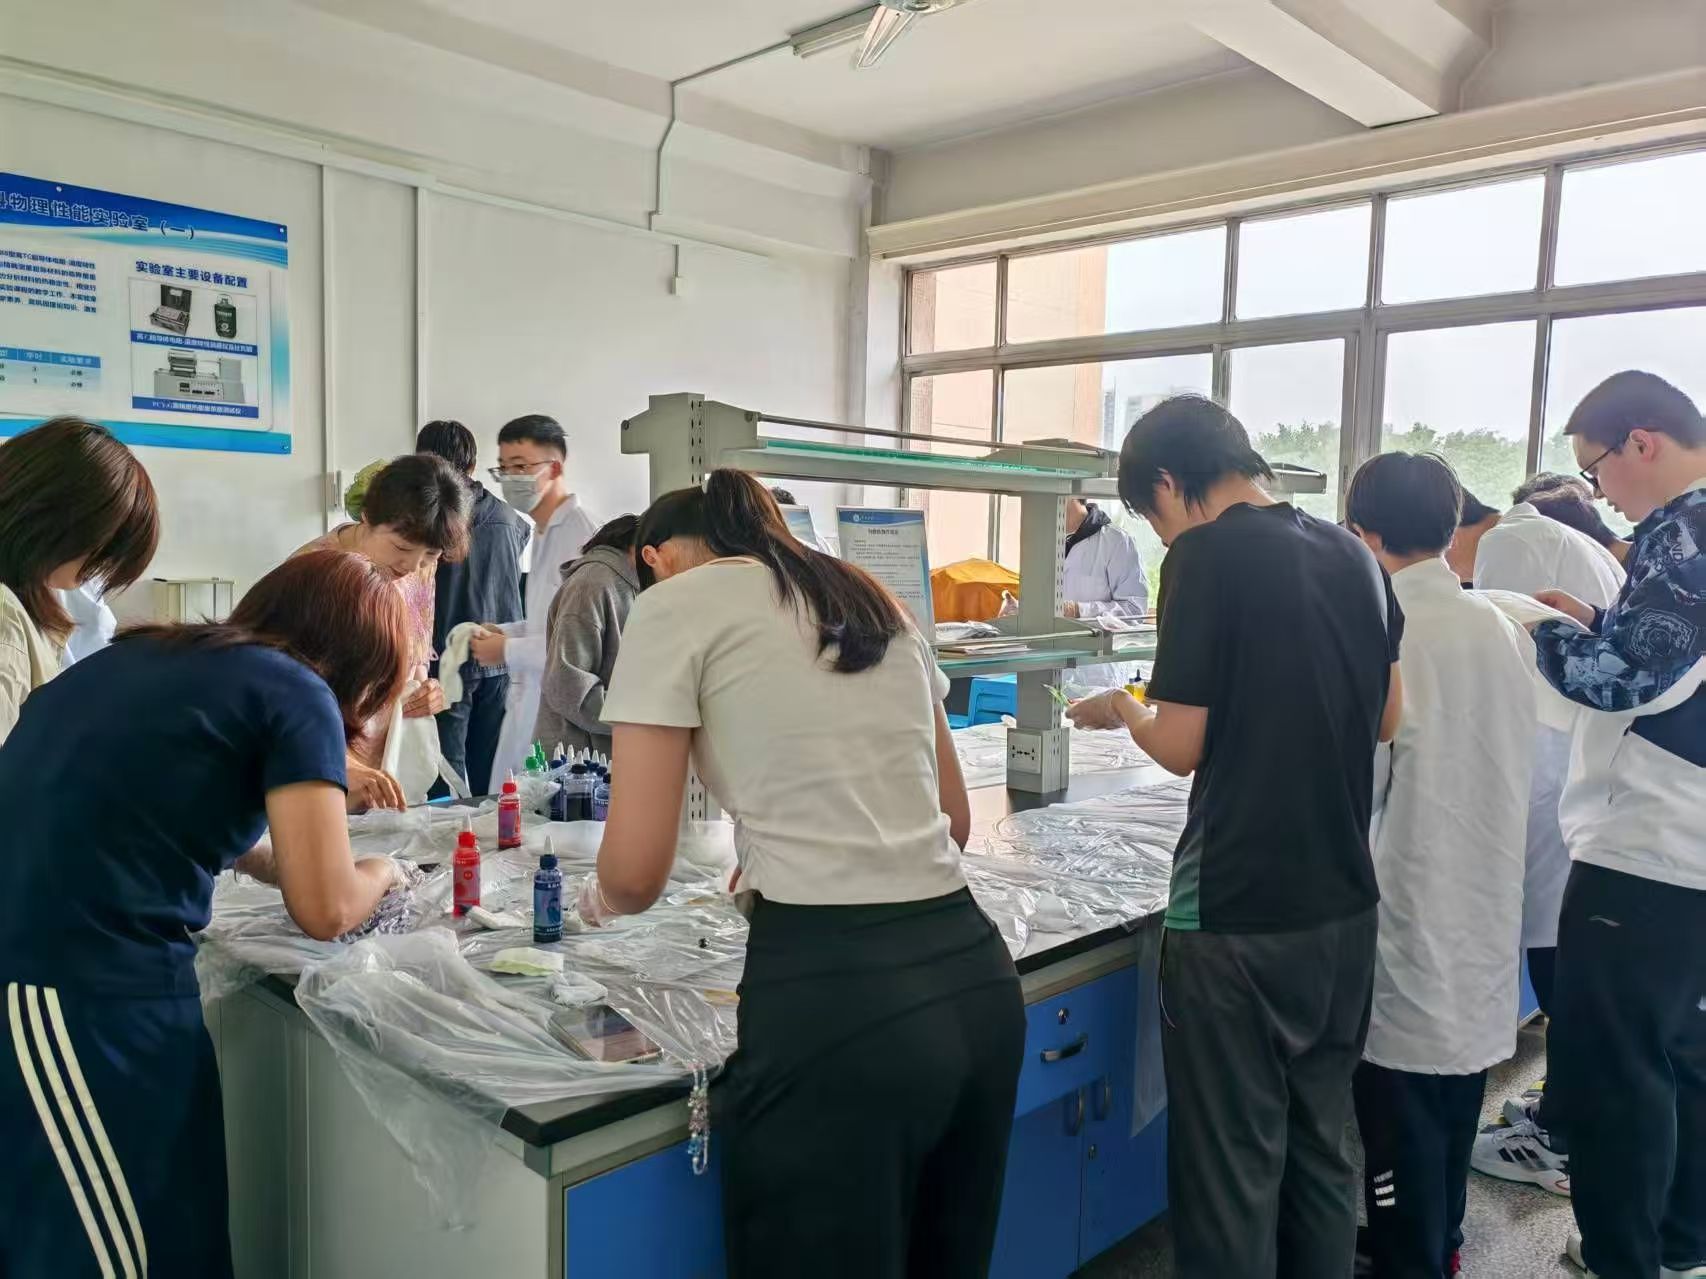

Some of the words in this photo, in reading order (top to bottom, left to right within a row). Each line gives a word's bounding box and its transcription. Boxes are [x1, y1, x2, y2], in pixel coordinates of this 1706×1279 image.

[135, 261, 248, 288] 实验室主要设备配置
